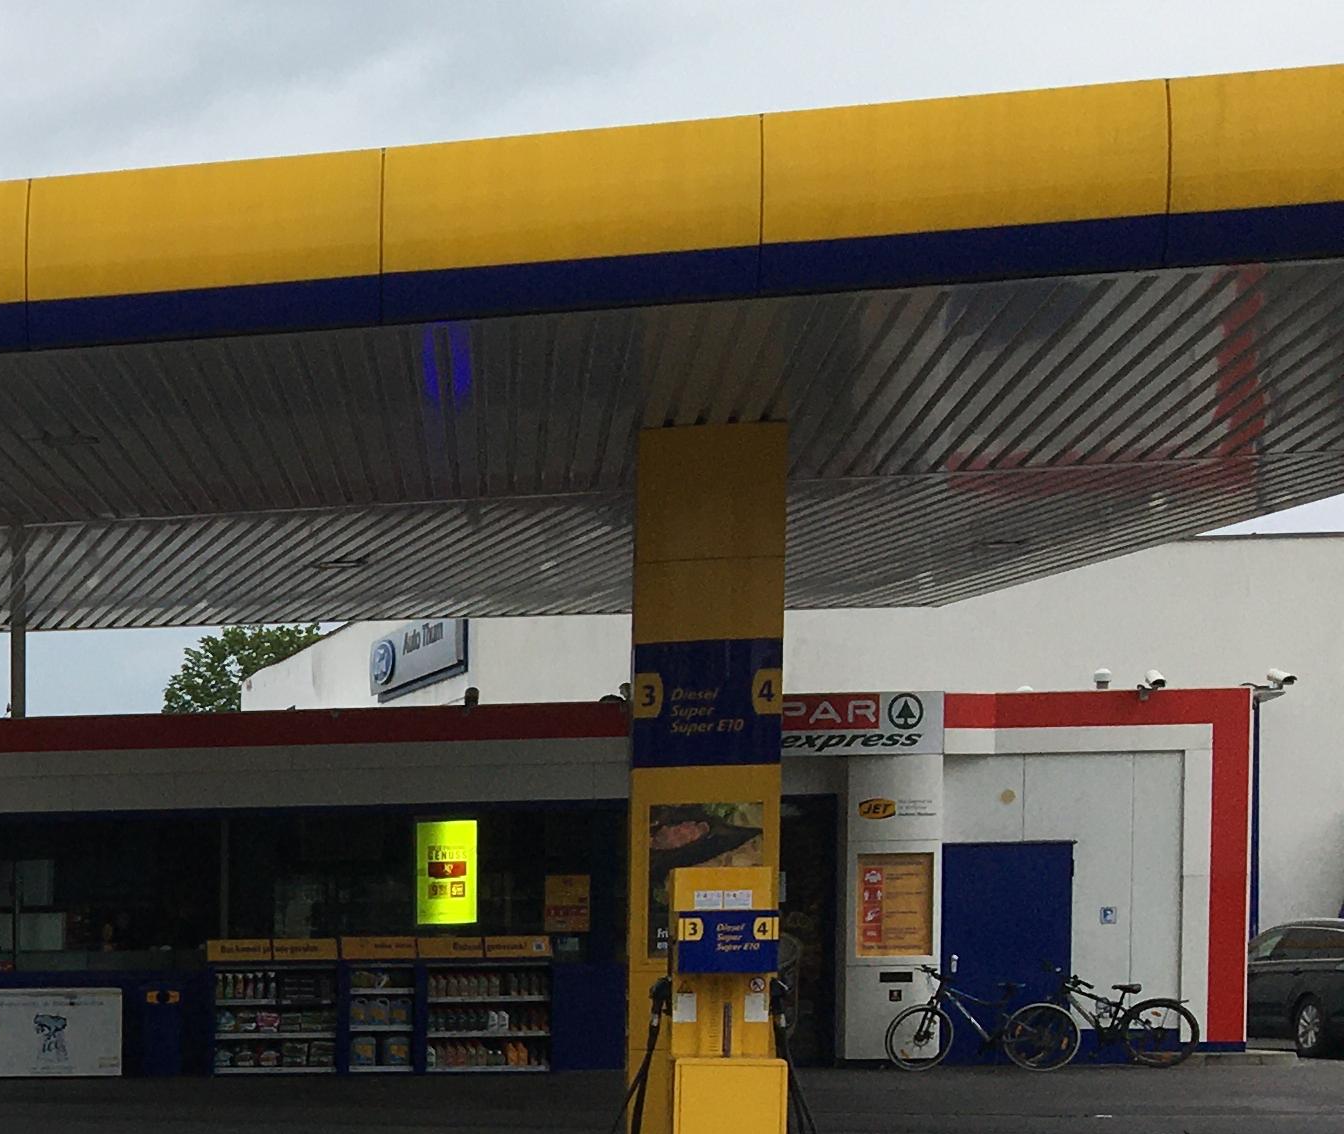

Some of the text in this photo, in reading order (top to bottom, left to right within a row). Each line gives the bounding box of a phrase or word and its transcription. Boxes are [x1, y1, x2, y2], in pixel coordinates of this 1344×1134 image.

[641, 685, 656, 707] 3
[670, 687, 720, 701] Diesel
[758, 679, 775, 702] 4
[670, 704, 715, 720] Super
[782, 699, 878, 724] PAR
[670, 718, 745, 737] Super E10
[782, 732, 923, 752] express
[863, 803, 892, 815] JET
[688, 922, 698, 936] 3
[757, 921, 769, 936] 4
